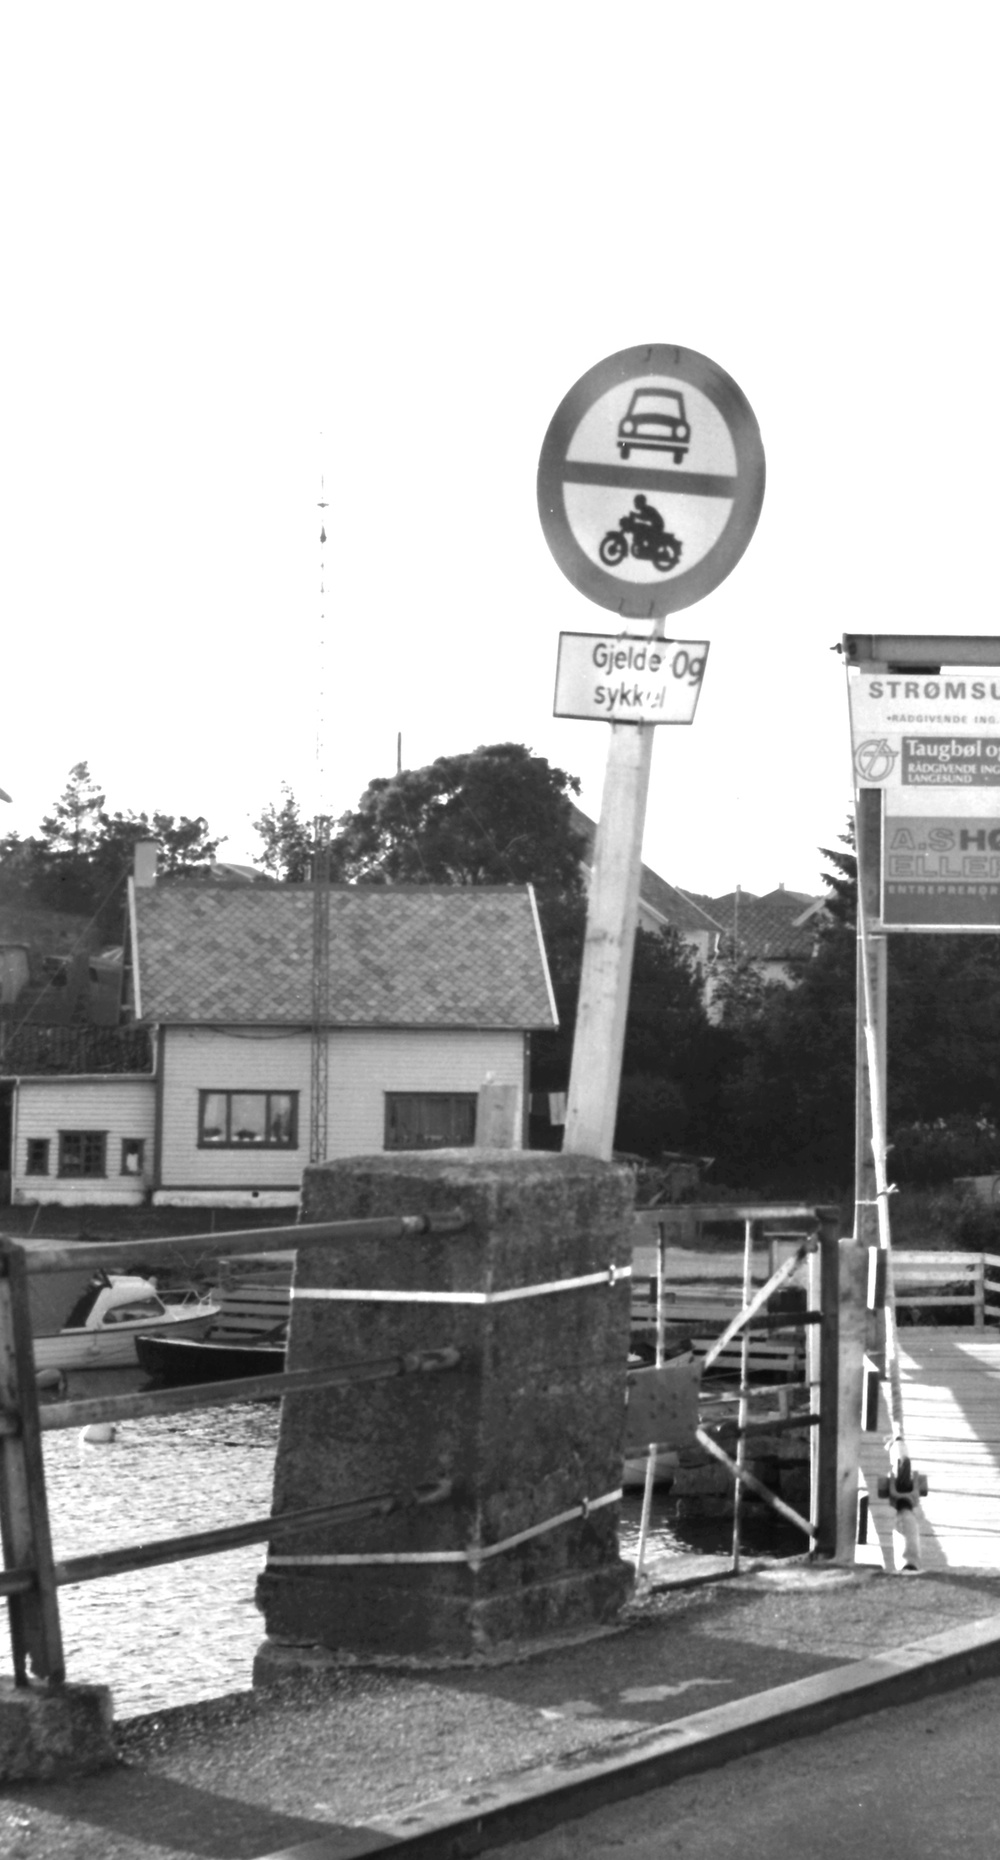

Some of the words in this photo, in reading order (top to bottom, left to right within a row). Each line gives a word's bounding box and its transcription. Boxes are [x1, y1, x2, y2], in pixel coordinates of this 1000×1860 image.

[593, 643, 668, 676] Gjelde
[906, 739, 982, 762] Taugbøl
[907, 773, 973, 783] LANGESUND
